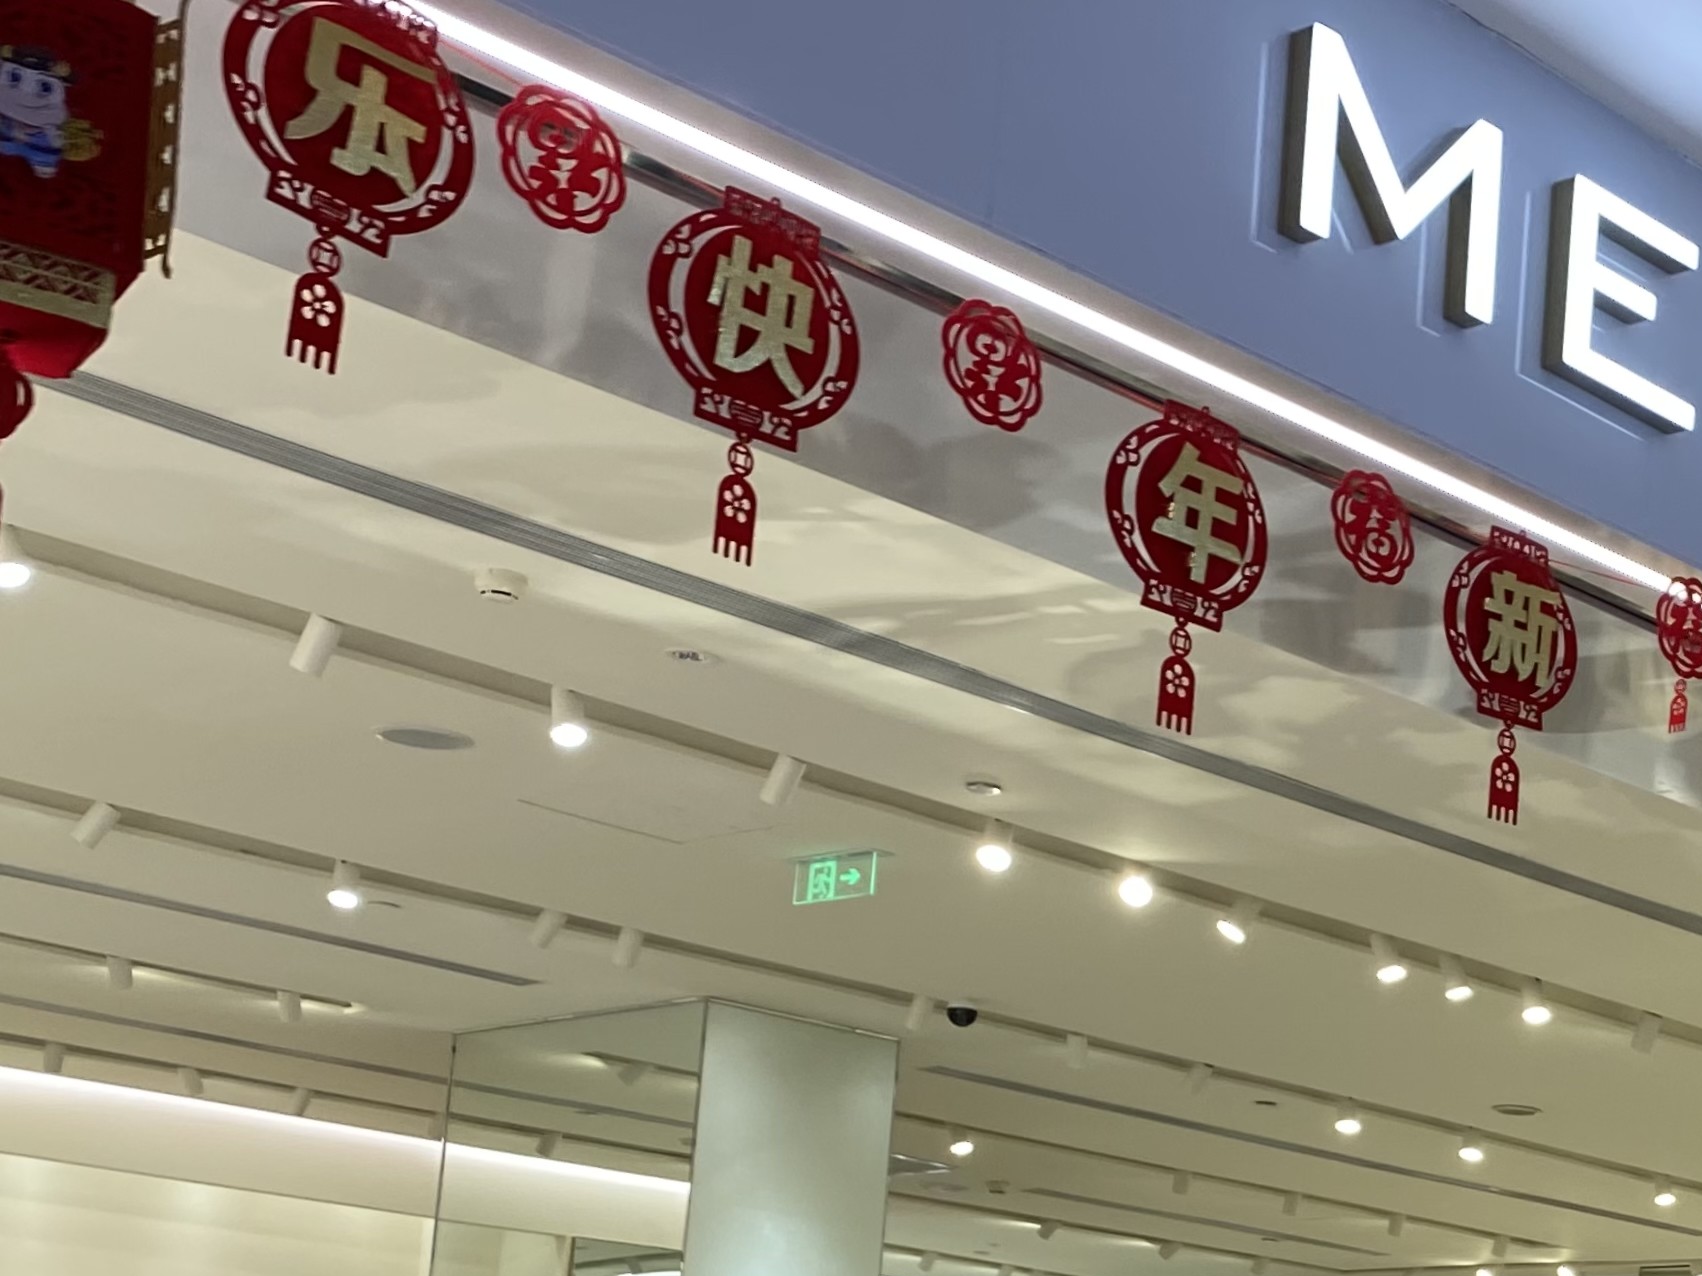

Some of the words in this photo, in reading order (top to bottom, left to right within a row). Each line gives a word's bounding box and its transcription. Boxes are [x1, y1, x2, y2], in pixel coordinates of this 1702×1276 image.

[1279, 22, 1699, 433] ME
[707, 235, 815, 397] 快
[1152, 442, 1244, 584] 年
[1482, 570, 1561, 688] 新
